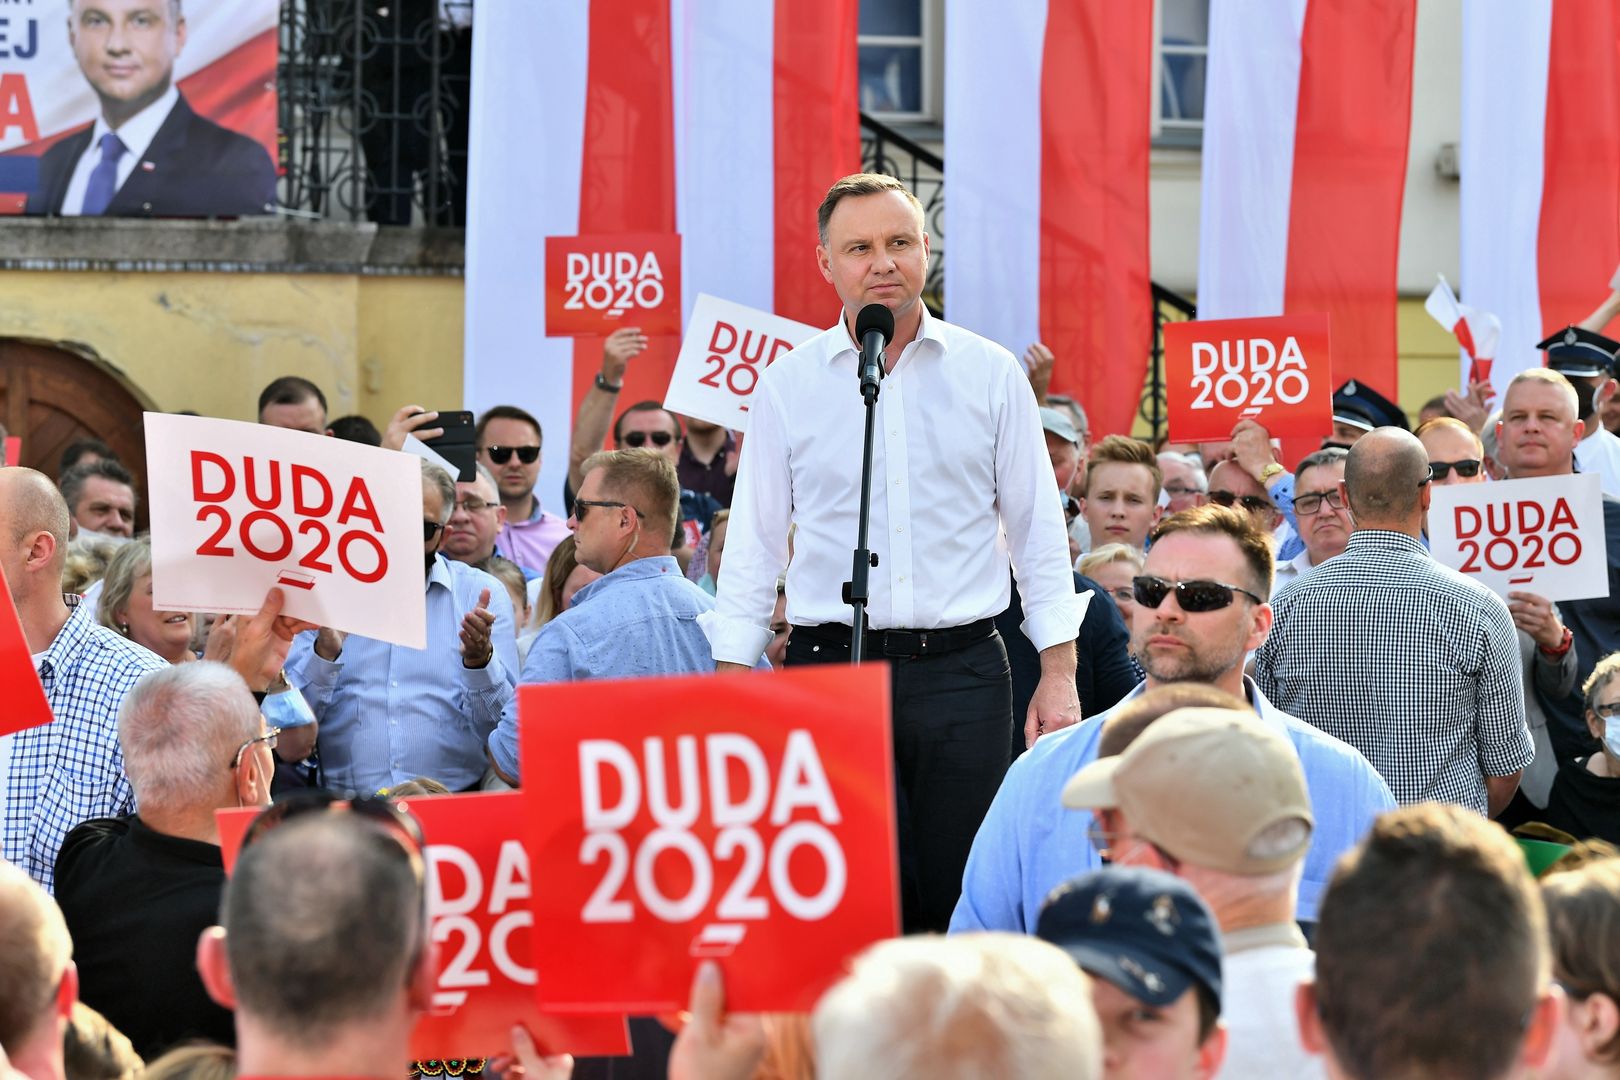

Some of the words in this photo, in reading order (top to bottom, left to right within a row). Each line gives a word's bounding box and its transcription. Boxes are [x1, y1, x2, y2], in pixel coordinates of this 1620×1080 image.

[567, 251, 663, 282] DUDA
[564, 280, 664, 310] 2020
[1191, 336, 1308, 375] DUDA
[1190, 369, 1310, 410] 2020
[190, 450, 384, 534] DUDA
[1454, 497, 1579, 540] DUDA
[196, 504, 389, 583] 2020
[1457, 531, 1583, 572] 2020
[579, 729, 841, 831] DUDA
[579, 821, 848, 922] 2020
